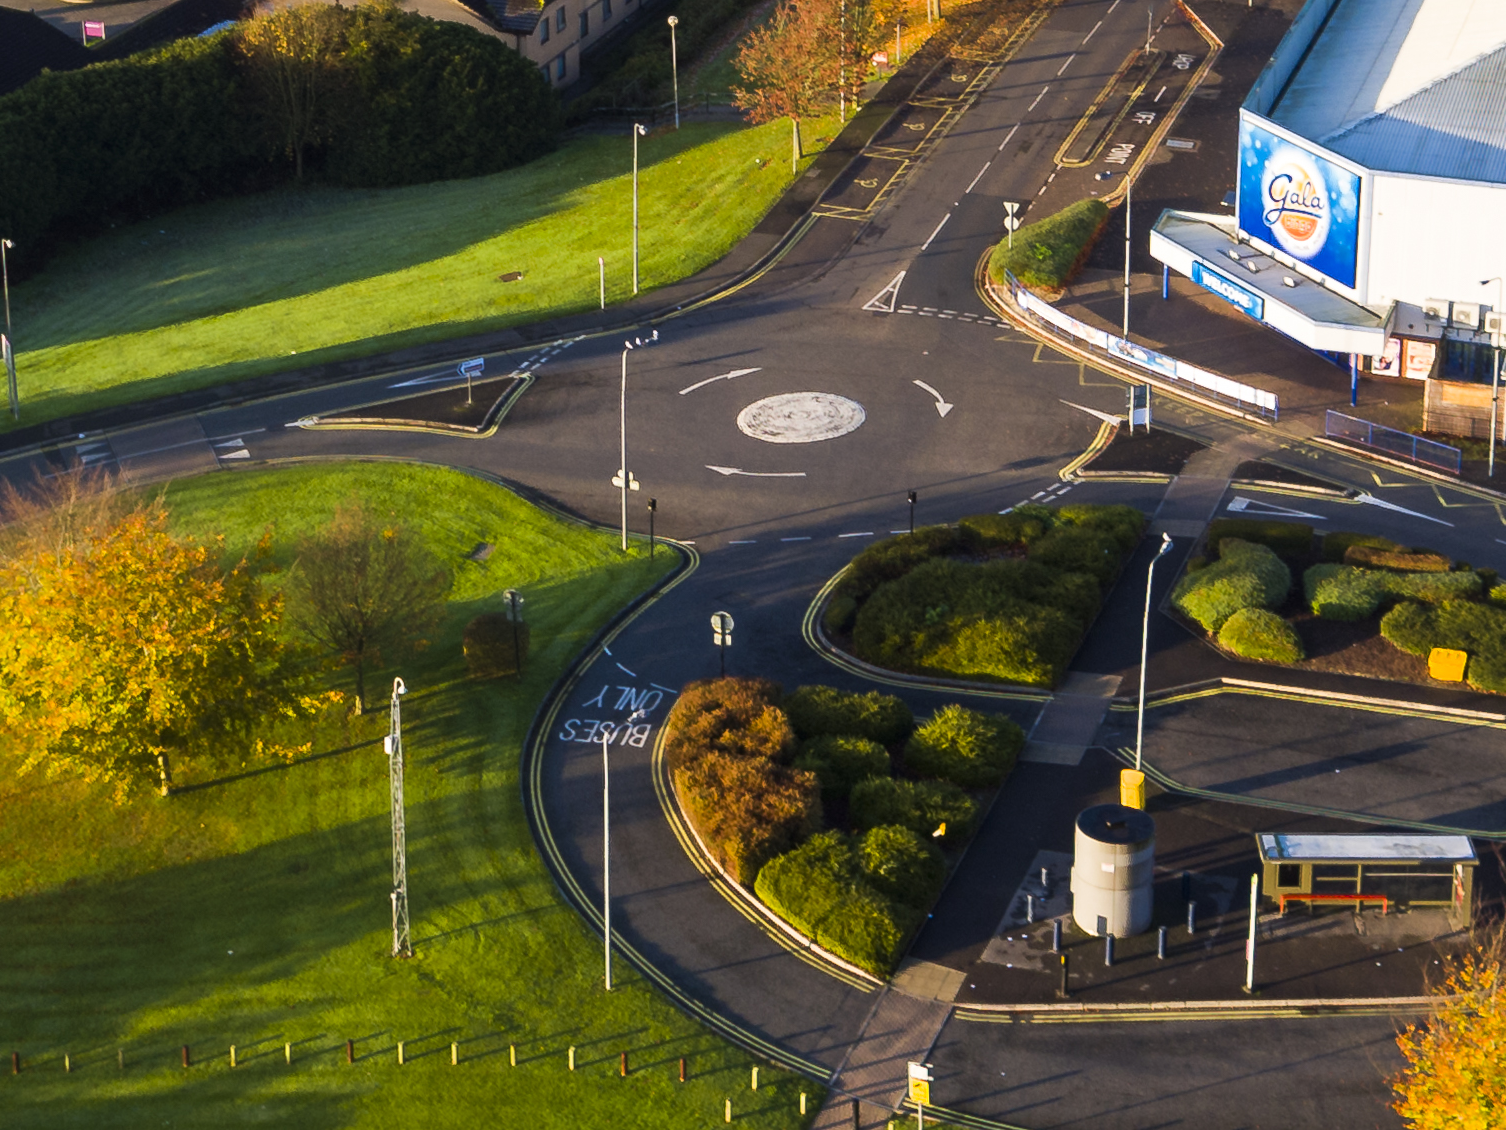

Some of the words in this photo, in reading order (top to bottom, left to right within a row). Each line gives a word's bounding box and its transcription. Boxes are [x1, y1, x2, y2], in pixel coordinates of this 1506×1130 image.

[1104, 143, 1136, 165] POINT
[1264, 173, 1324, 225] Gala
[1201, 271, 1251, 309] WELCOME
[582, 685, 663, 711] ONLY
[559, 719, 651, 748] BUSES
